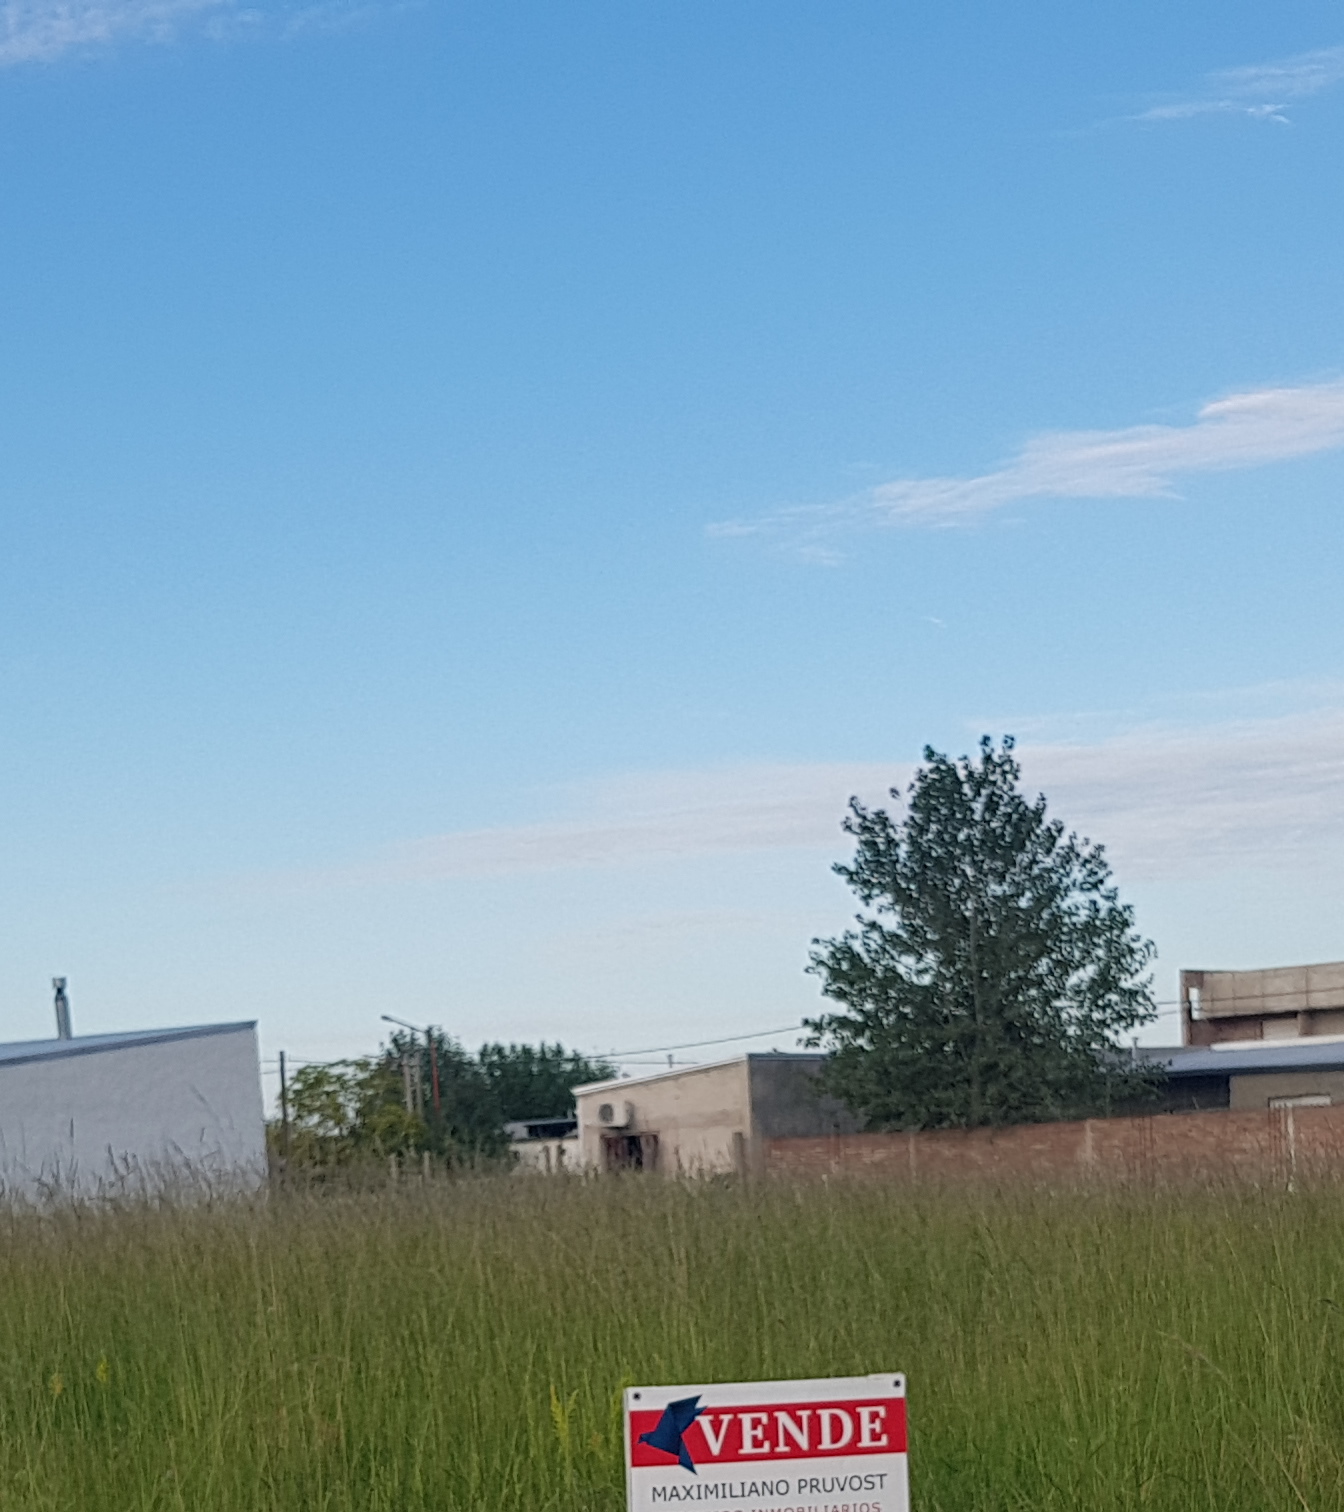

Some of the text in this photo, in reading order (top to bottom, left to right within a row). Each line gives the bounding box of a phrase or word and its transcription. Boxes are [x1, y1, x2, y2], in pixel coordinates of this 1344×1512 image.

[696, 1406, 888, 1456] VENDE
[652, 1474, 888, 1502] MAXIMILIANO PRUVOST
